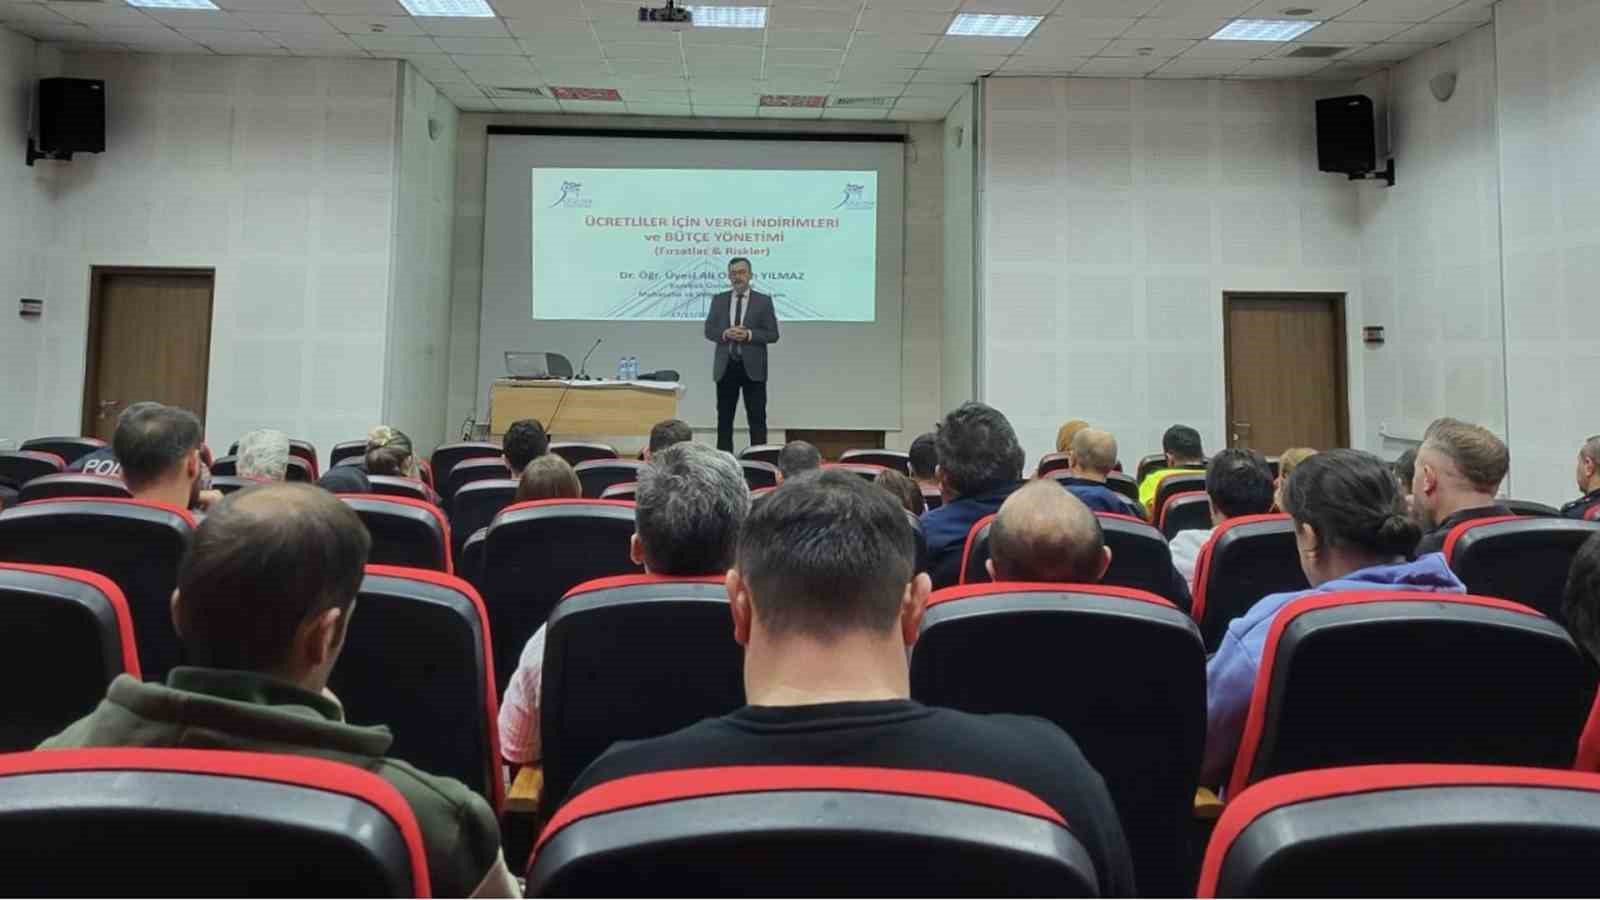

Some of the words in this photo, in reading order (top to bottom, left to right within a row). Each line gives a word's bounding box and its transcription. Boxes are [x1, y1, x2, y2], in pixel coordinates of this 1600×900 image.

[585, 215, 668, 227] ÜCRETLİLER
[672, 216, 700, 228] İÇİN
[665, 231, 710, 243] BÜTÇE
[714, 231, 784, 242] YÖNETİMİ
